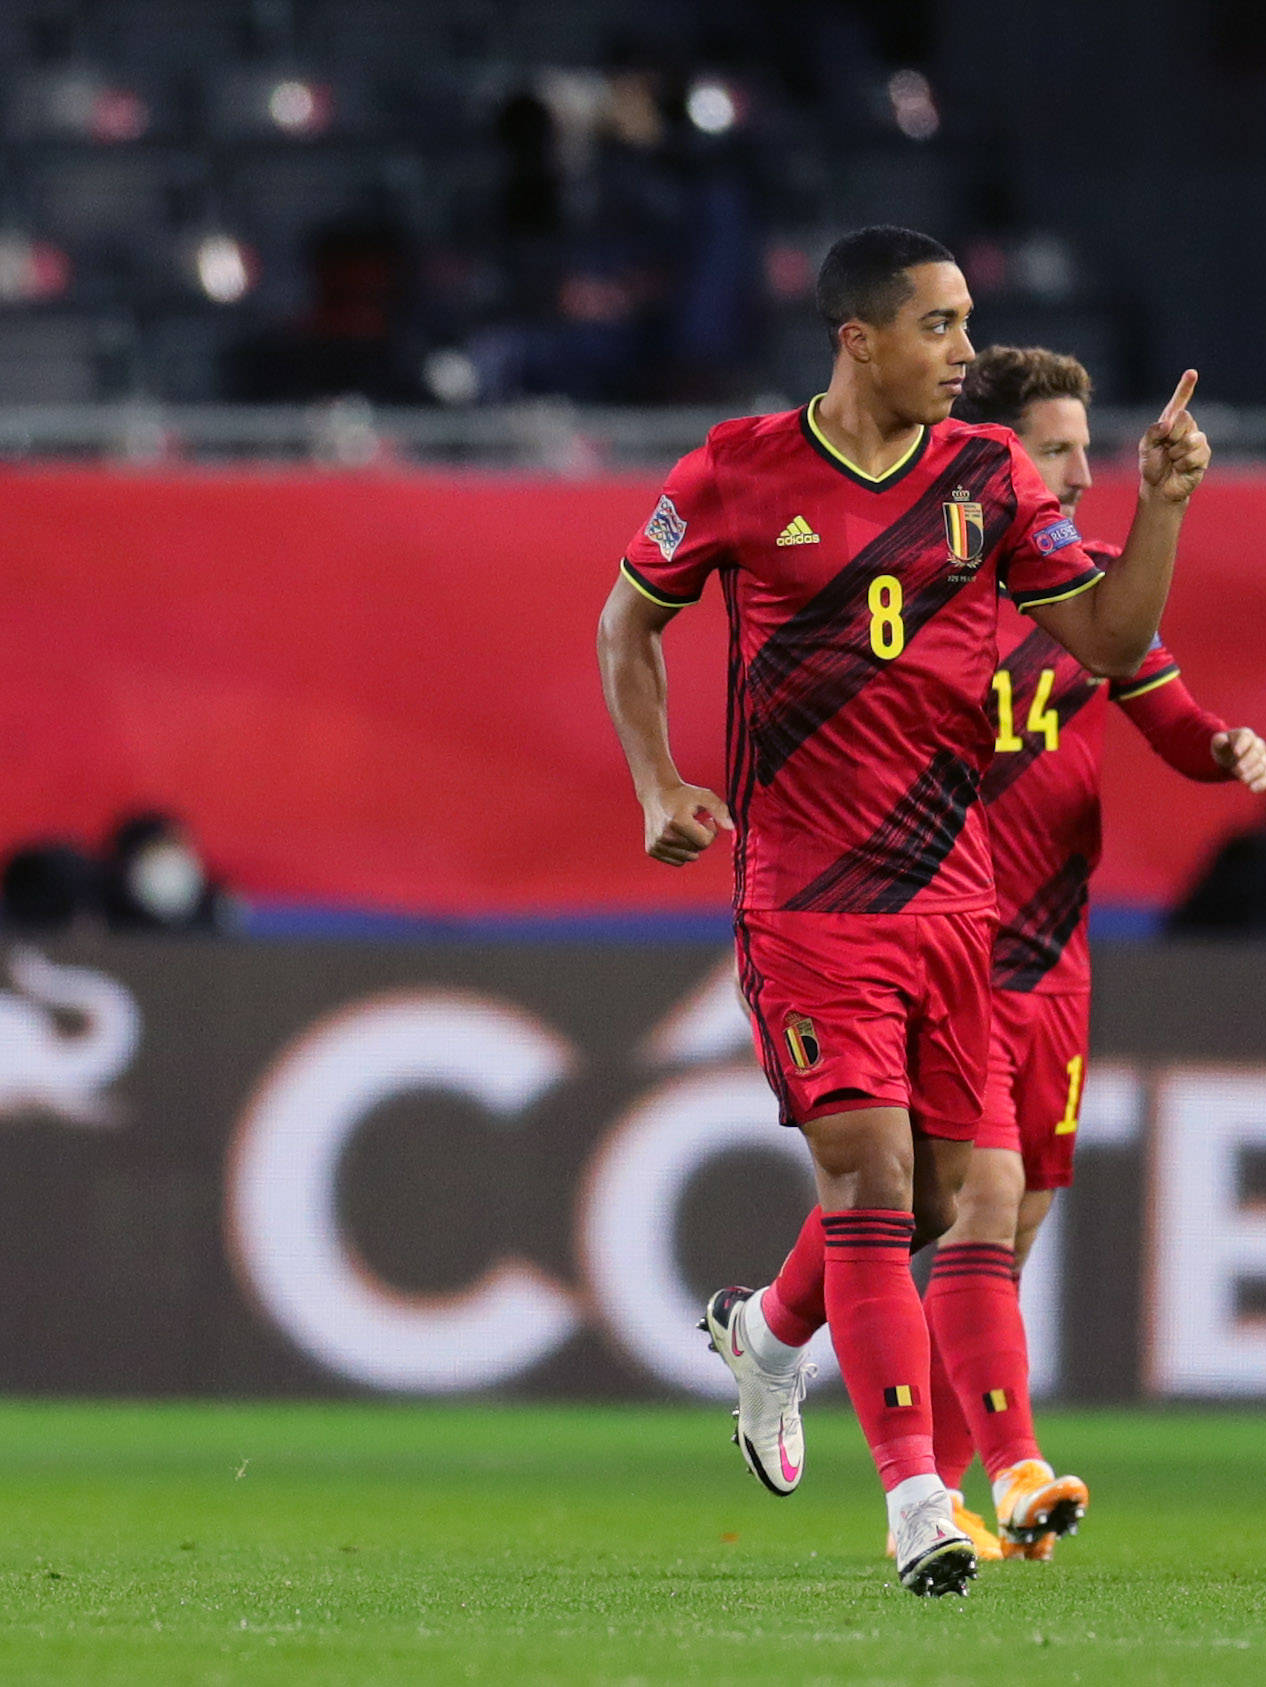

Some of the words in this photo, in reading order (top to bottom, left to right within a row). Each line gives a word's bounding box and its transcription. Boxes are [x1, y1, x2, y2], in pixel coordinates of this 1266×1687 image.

[776, 533, 820, 547] adidas
[868, 574, 905, 660] 8
[991, 668, 1060, 753] 14
